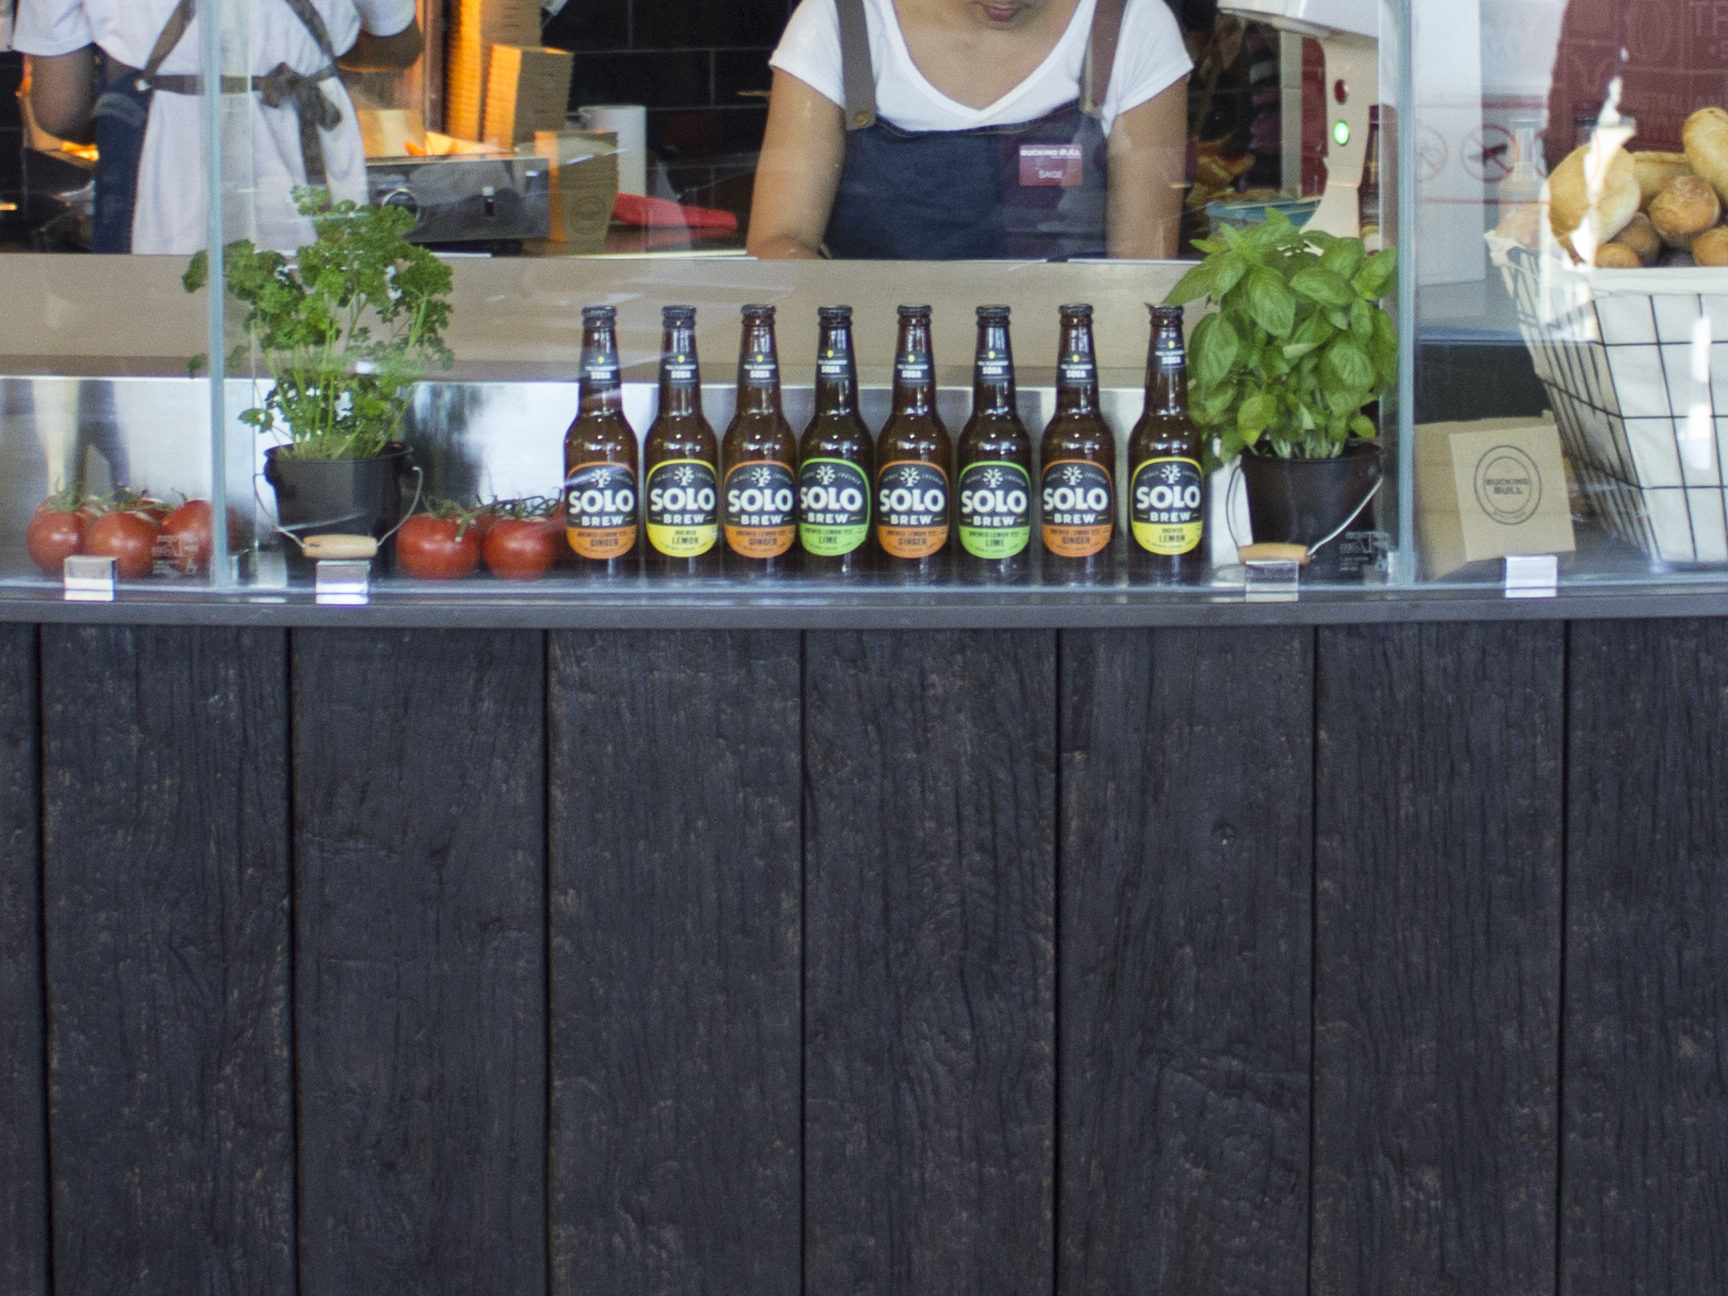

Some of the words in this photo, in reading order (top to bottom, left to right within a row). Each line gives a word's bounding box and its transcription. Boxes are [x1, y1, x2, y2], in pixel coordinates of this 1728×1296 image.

[569, 488, 634, 514] SOLO
[650, 486, 715, 511] SOLO
[727, 487, 793, 512] SOLO
[801, 486, 863, 511] SOLO
[880, 489, 945, 513] SOLO
[962, 490, 1027, 515] SOLO
[1043, 488, 1109, 511] SOLO
[1136, 485, 1201, 510] SOLO
[581, 515, 623, 527] BREW
[663, 513, 706, 525] BREW
[740, 514, 783, 525] BREW
[808, 512, 849, 525] BREW
[890, 514, 933, 525] BREW
[973, 515, 1016, 527] BREW
[1054, 512, 1096, 524] BREW
[1150, 511, 1192, 523] BREW
